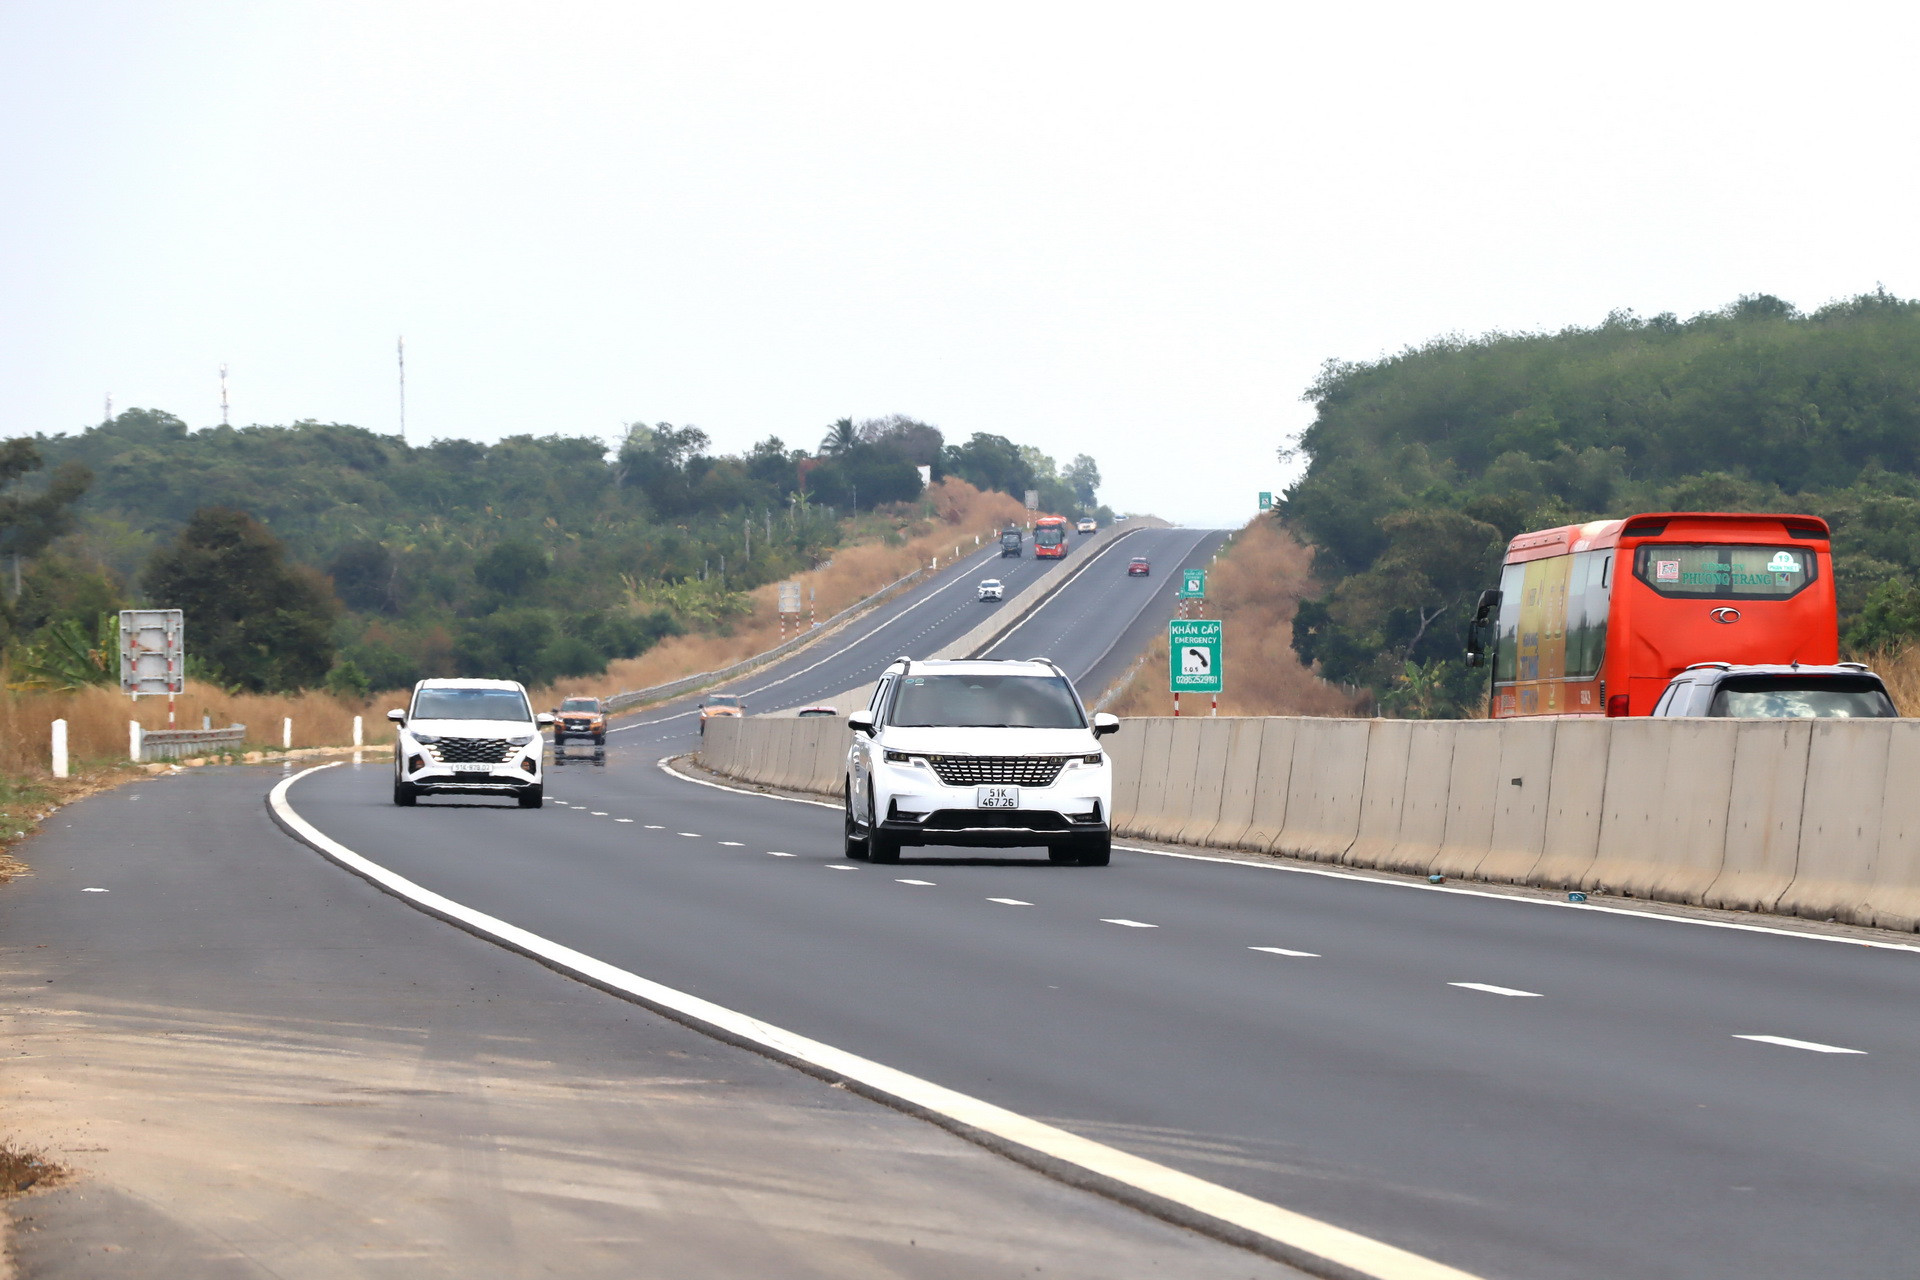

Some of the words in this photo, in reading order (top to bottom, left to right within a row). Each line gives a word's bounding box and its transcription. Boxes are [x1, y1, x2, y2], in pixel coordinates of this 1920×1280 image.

[1732, 573, 1772, 585] TRANG
[1201, 623, 1219, 635] CẤP
[1175, 636, 1217, 644] EMERGENCY
[990, 789, 1007, 797] 51K
[983, 798, 1014, 807] 467.26
